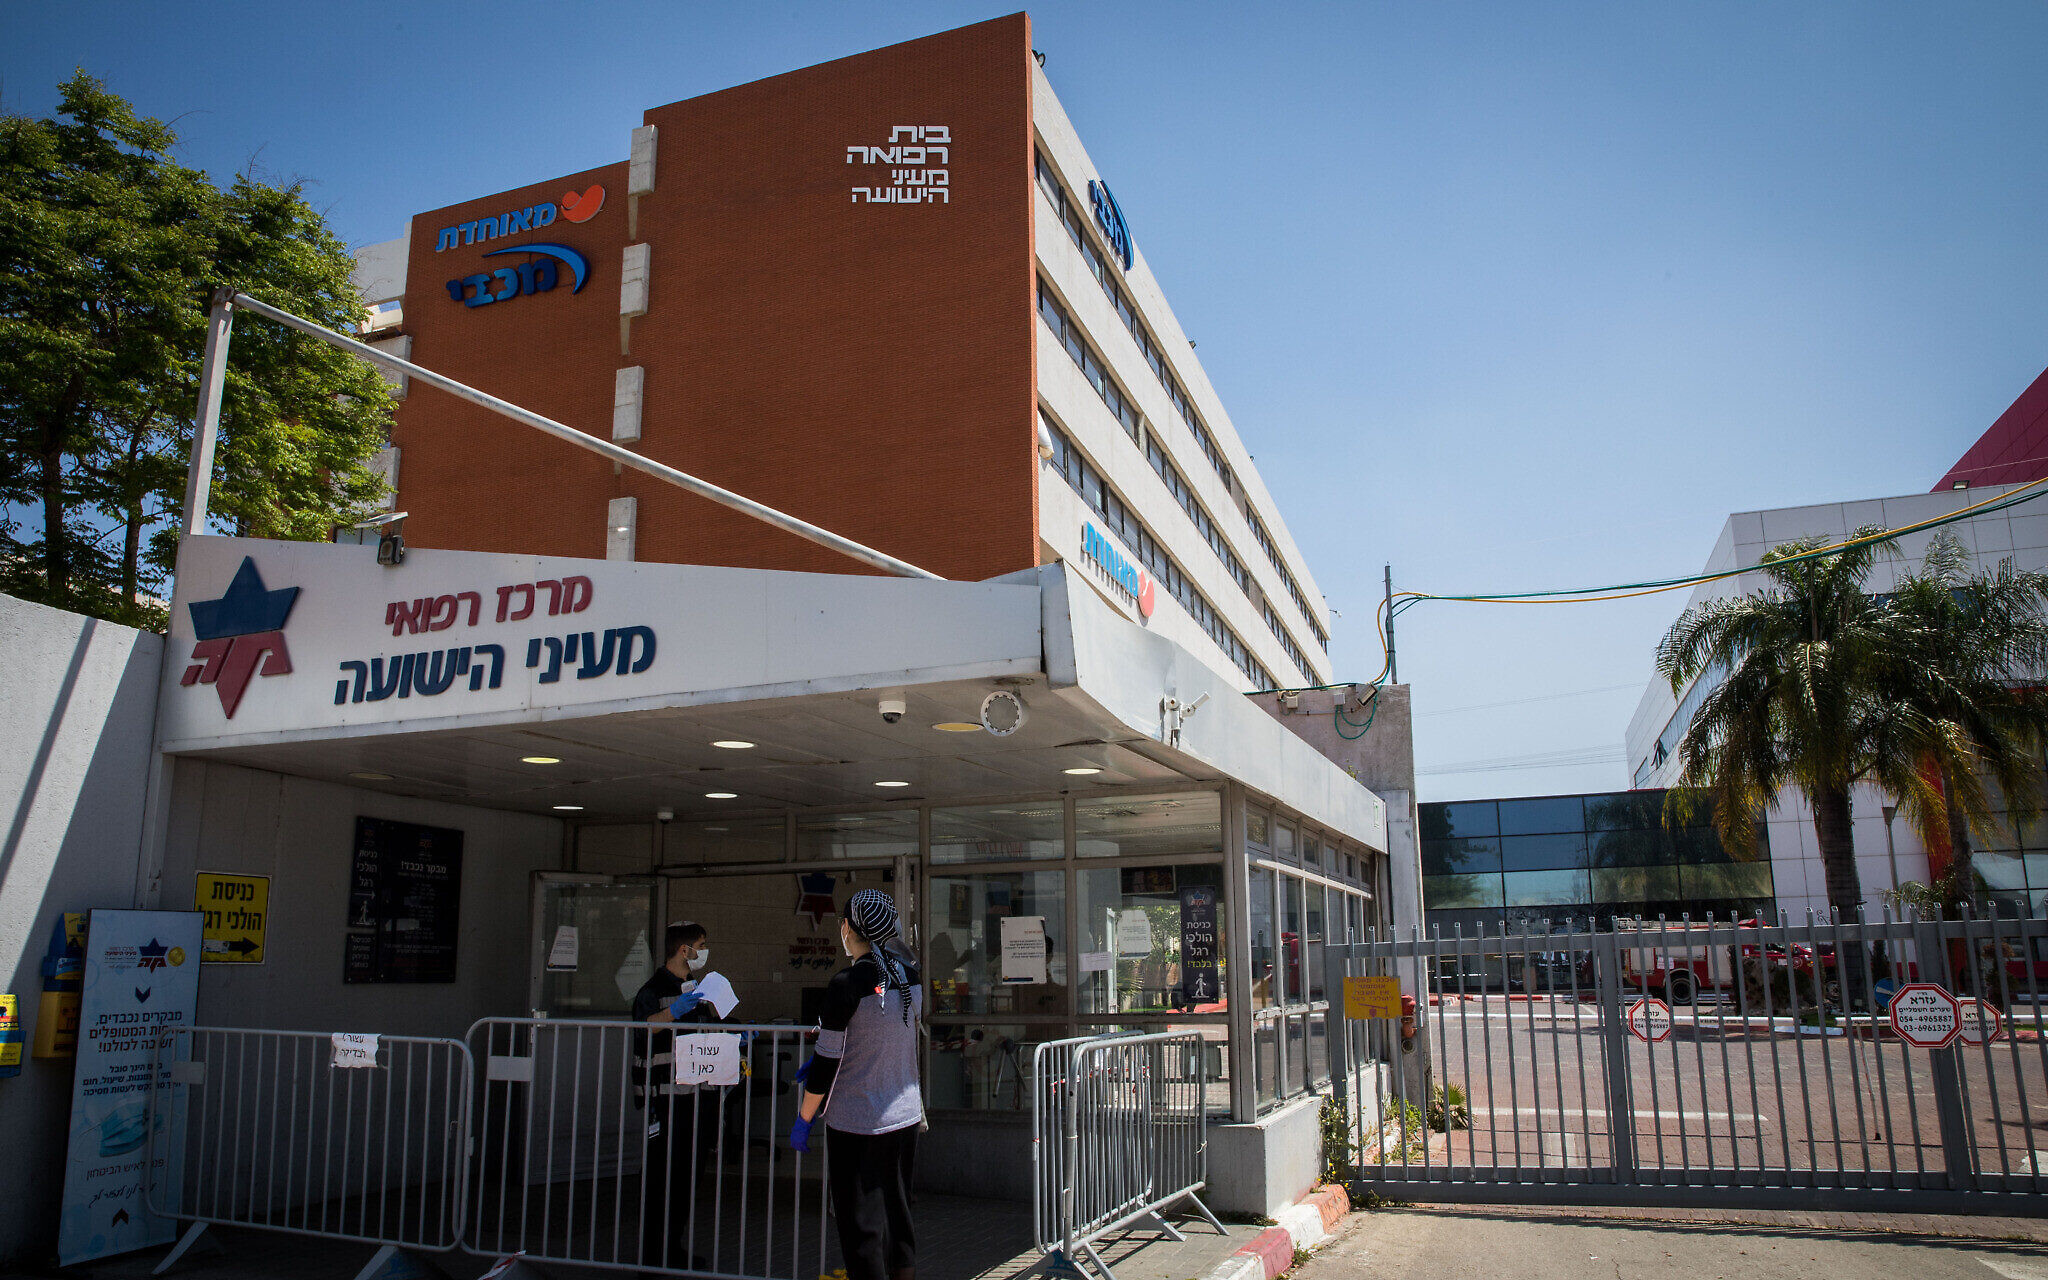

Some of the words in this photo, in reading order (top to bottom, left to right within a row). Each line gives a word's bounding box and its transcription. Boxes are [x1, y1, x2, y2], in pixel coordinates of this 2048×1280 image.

[889, 125, 952, 143] בית
[847, 146, 949, 164] רפואה
[891, 169, 949, 186] מעיני
[852, 187, 949, 203] הישועה
[435, 202, 558, 253] מאוחדת
[446, 258, 560, 309] מכבי
[1081, 521, 1139, 600] מאוחדת
[496, 575, 594, 623] מרכז
[385, 591, 482, 636] רפואי
[526, 625, 658, 685] מעיני
[335, 643, 505, 705] הישועה
[401, 861, 424, 870] נכבד!
[425, 863, 447, 874] מבקר
[359, 875, 374, 887] רגל
[212, 881, 254, 901] כניסת
[227, 906, 262, 930] הולכי
[1186, 921, 1211, 929] כניסת
[1185, 931, 1213, 943] הולכי
[1189, 944, 1208, 956] רגל
[1187, 959, 1213, 968] בלבד!
[1910, 995, 1937, 1005] עזרא
[95, 1012, 140, 1026] נכבדים,
[142, 1010, 184, 1025] מבקרים
[1899, 1015, 1953, 1023] 054-4965887
[89, 1025, 147, 1039] המטופלים
[1903, 1024, 1952, 1032] 03-6961323
[98, 1038, 138, 1053] לכולנו!
[697, 1046, 720, 1056] עצור
[109, 1065, 128, 1074] סובל
[148, 1062, 164, 1071] בם
[698, 1064, 715, 1076] כאן
